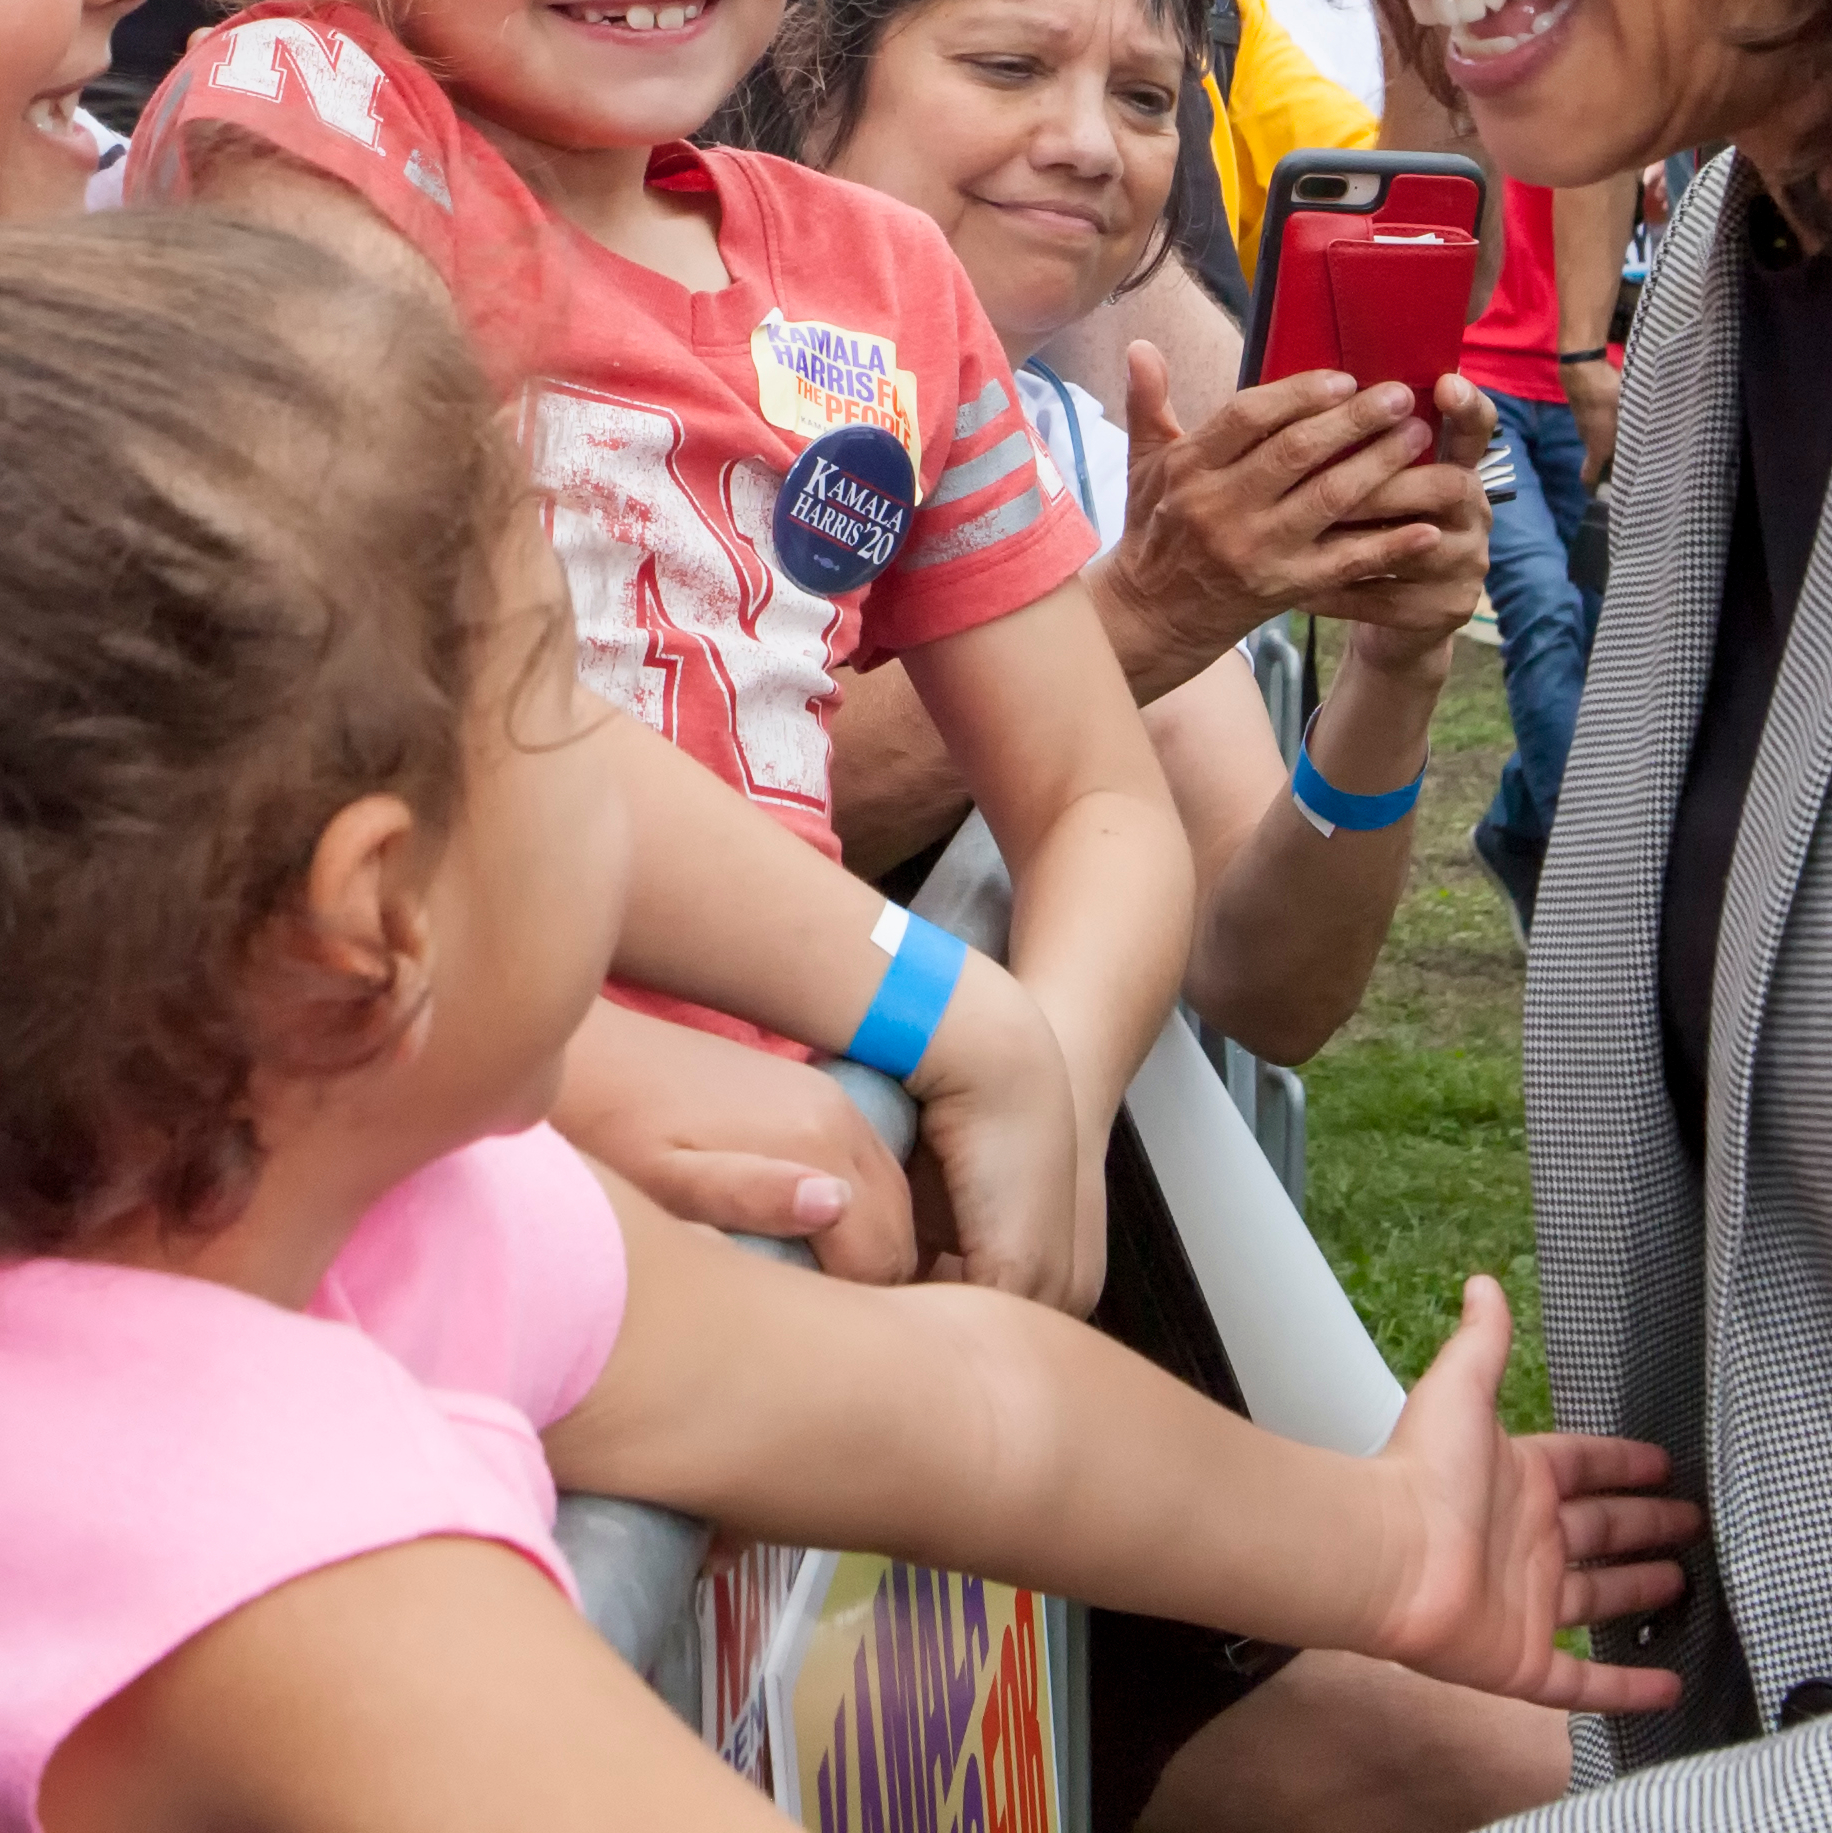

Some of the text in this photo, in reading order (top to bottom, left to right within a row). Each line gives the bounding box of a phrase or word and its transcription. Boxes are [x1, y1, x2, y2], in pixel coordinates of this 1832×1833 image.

[767, 323, 886, 376] KAMALA
[772, 344, 874, 404] HARRIS
[795, 375, 824, 407] THE
[790, 492, 864, 548] HARRIS
[803, 455, 905, 534] KAMALA
